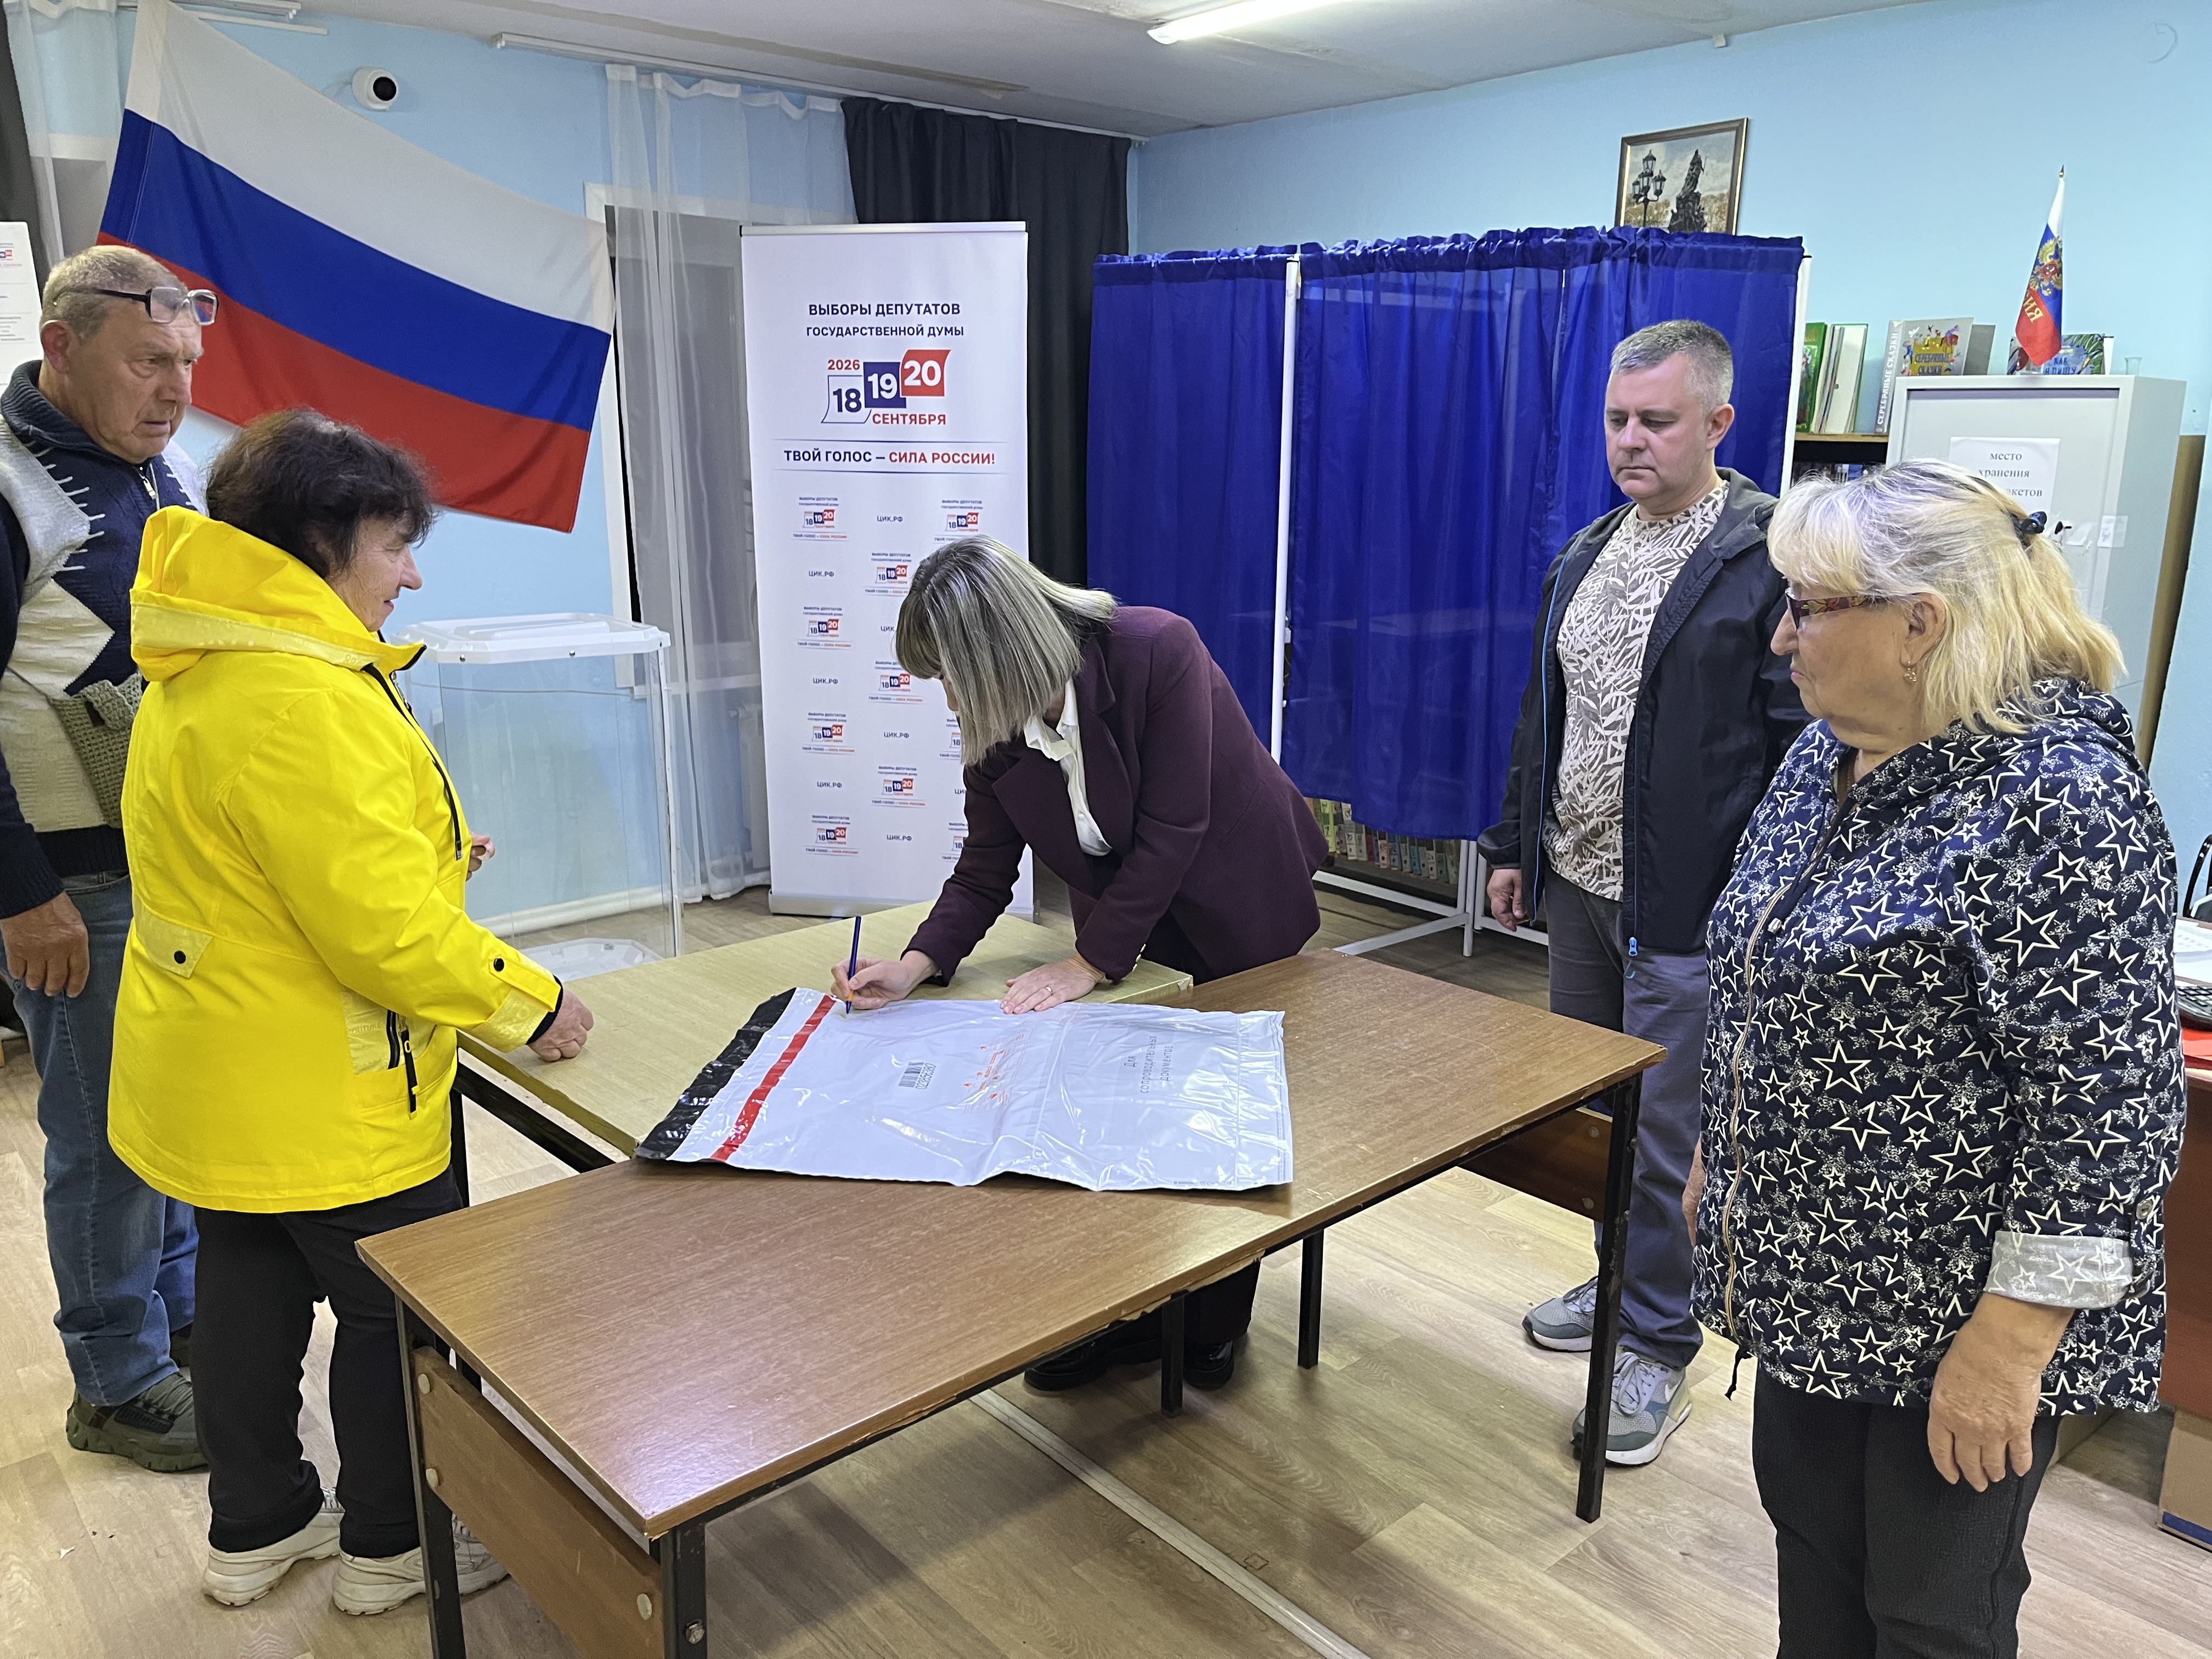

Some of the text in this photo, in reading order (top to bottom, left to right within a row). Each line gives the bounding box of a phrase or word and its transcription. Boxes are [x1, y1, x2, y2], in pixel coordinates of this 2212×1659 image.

[809, 303, 960, 317] ВЫБОРЫ ДЕПУТАТОВ
[807, 324, 964, 337] ГОСУДАРСТВЕННОЙ ДУМЫ
[828, 359, 860, 370] 2026
[2053, 357, 2068, 365] КАК
[1877, 332, 1899, 425] СЕРЕБРЯНЫЕ СКАЗКИ
[833, 360, 941, 413] 18 19 20
[872, 413, 946, 425] СЕНТЯБРЯ
[784, 448, 821, 461] ТВОЙ
[826, 450, 872, 462] ГОЛОС
[889, 452, 927, 463] СИЛА
[932, 453, 995, 464] РОССИИ!
[1124, 1056, 1138, 1068] Для
[1160, 1046, 1173, 1081] документов
